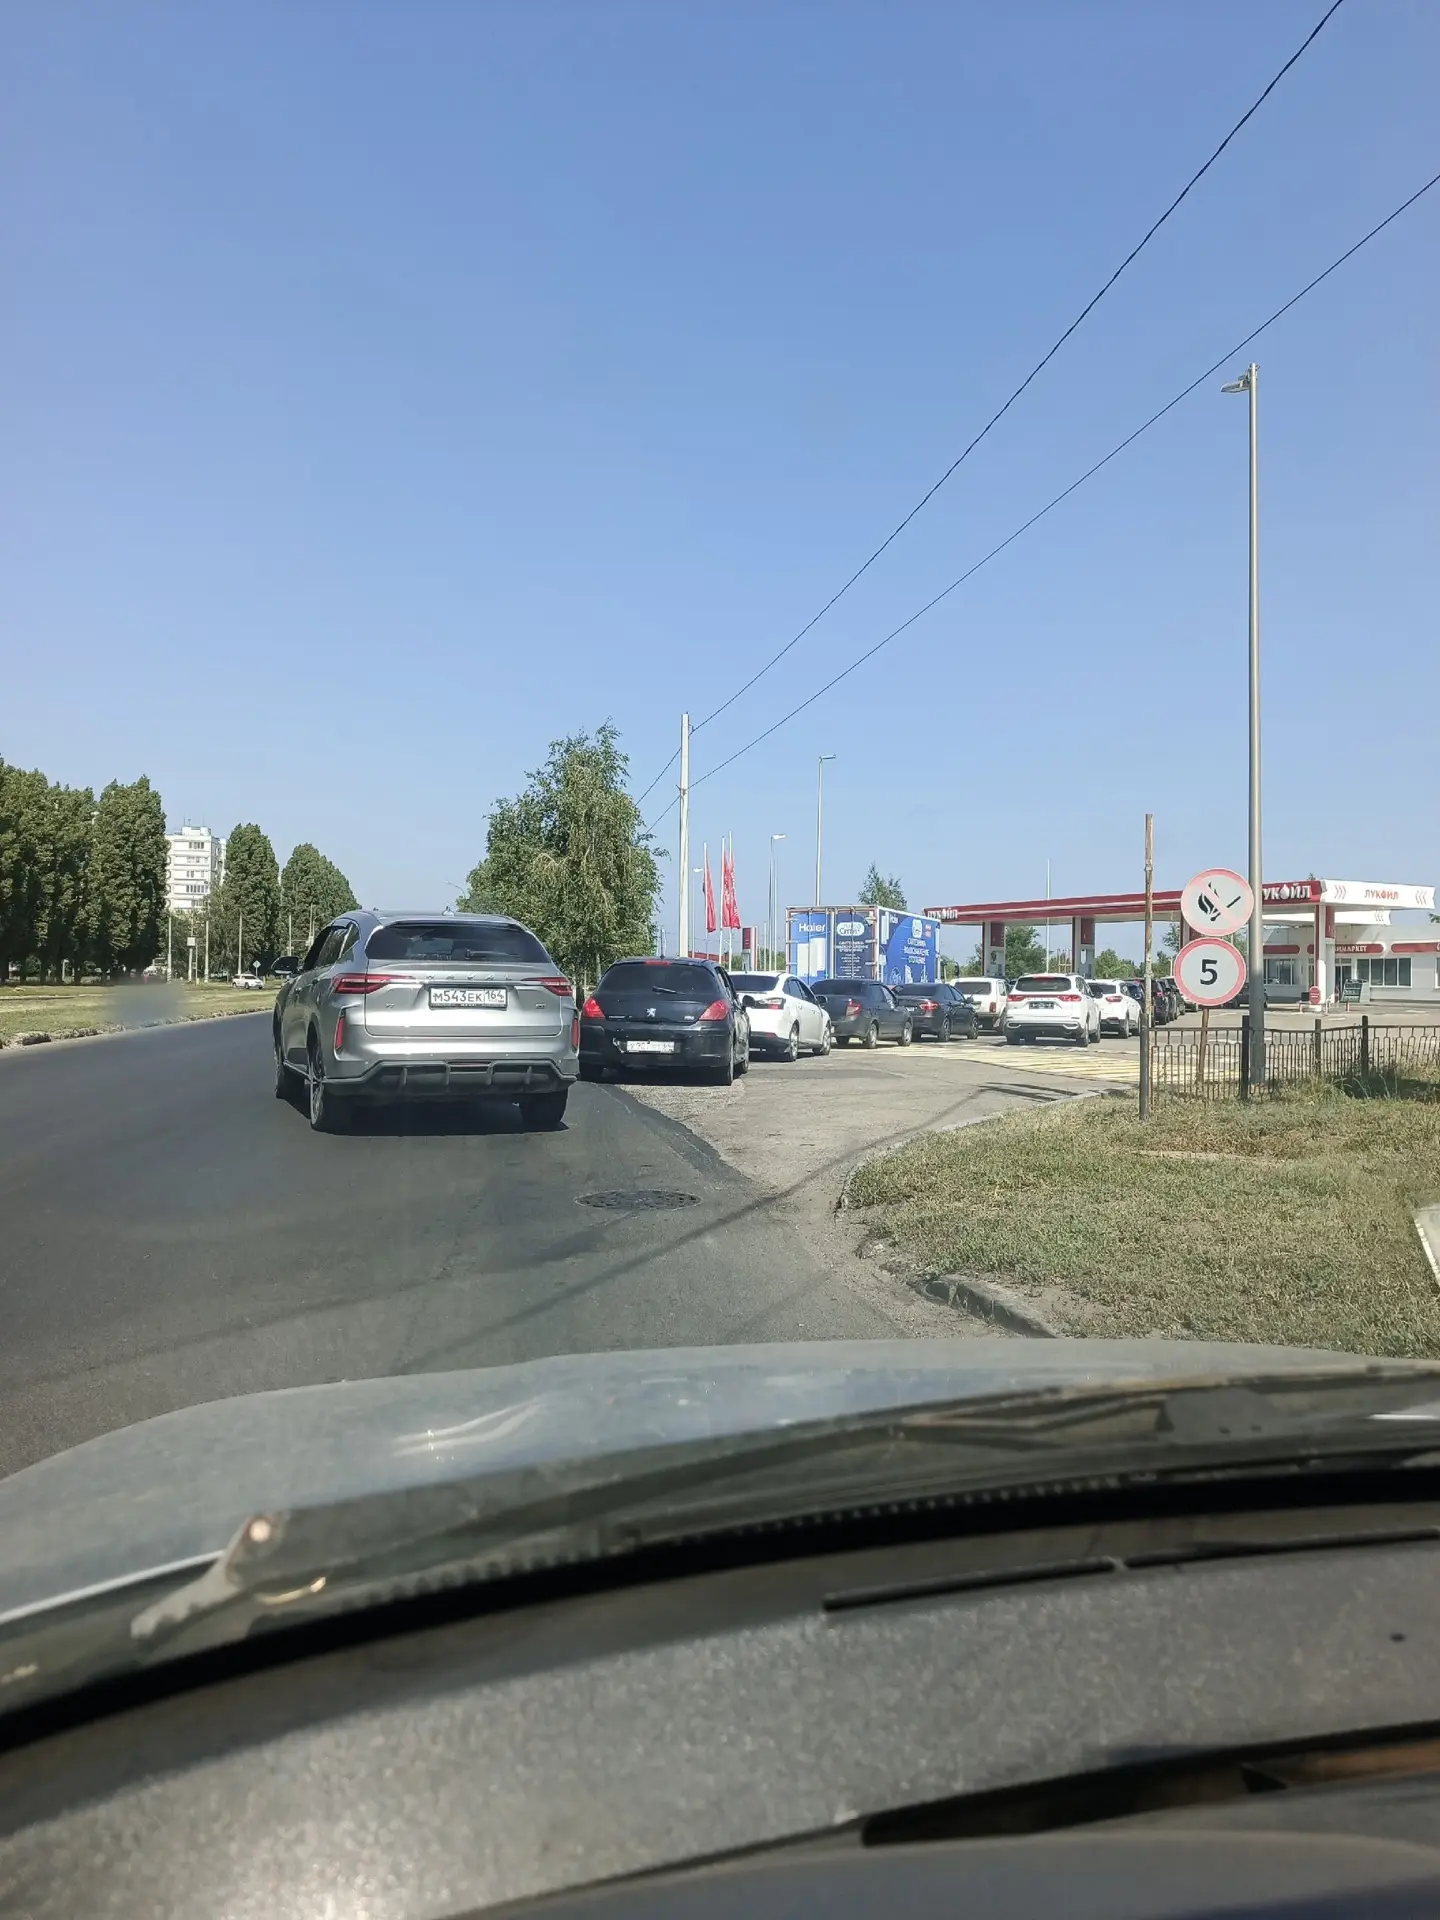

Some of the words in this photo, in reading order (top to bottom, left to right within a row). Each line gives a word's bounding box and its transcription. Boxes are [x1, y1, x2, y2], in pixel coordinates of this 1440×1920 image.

[1264, 881, 1312, 901] УКОЙЛ
[1364, 887, 1400, 901] ЛУКОЙЛ
[798, 923, 826, 932] Haier
[1336, 945, 1368, 953] ИМАРКЕТ
[1199, 958, 1218, 986] 5
[432, 990, 483, 1002] М543ЕК
[484, 989, 504, 1000] 164
